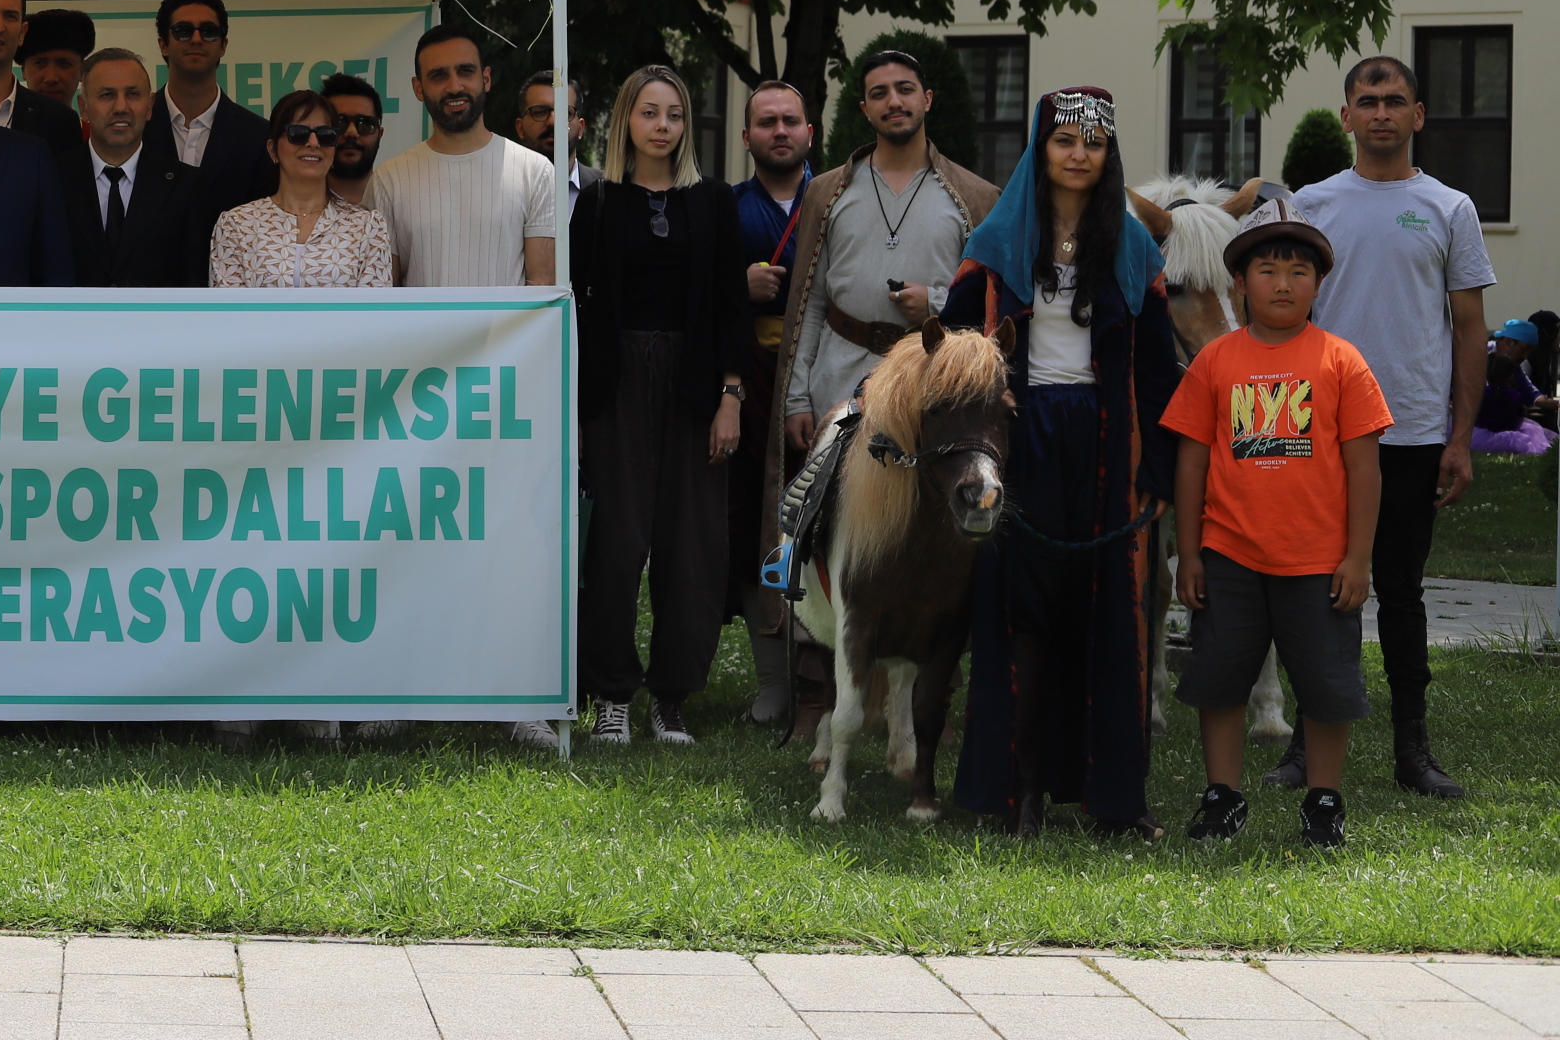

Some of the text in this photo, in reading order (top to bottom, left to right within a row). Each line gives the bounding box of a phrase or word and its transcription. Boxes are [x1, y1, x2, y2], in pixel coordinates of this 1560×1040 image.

[82, 366, 532, 443] GELENEKSEL
[1231, 380, 1312, 437] NYC
[182, 467, 485, 541] DALLARI
